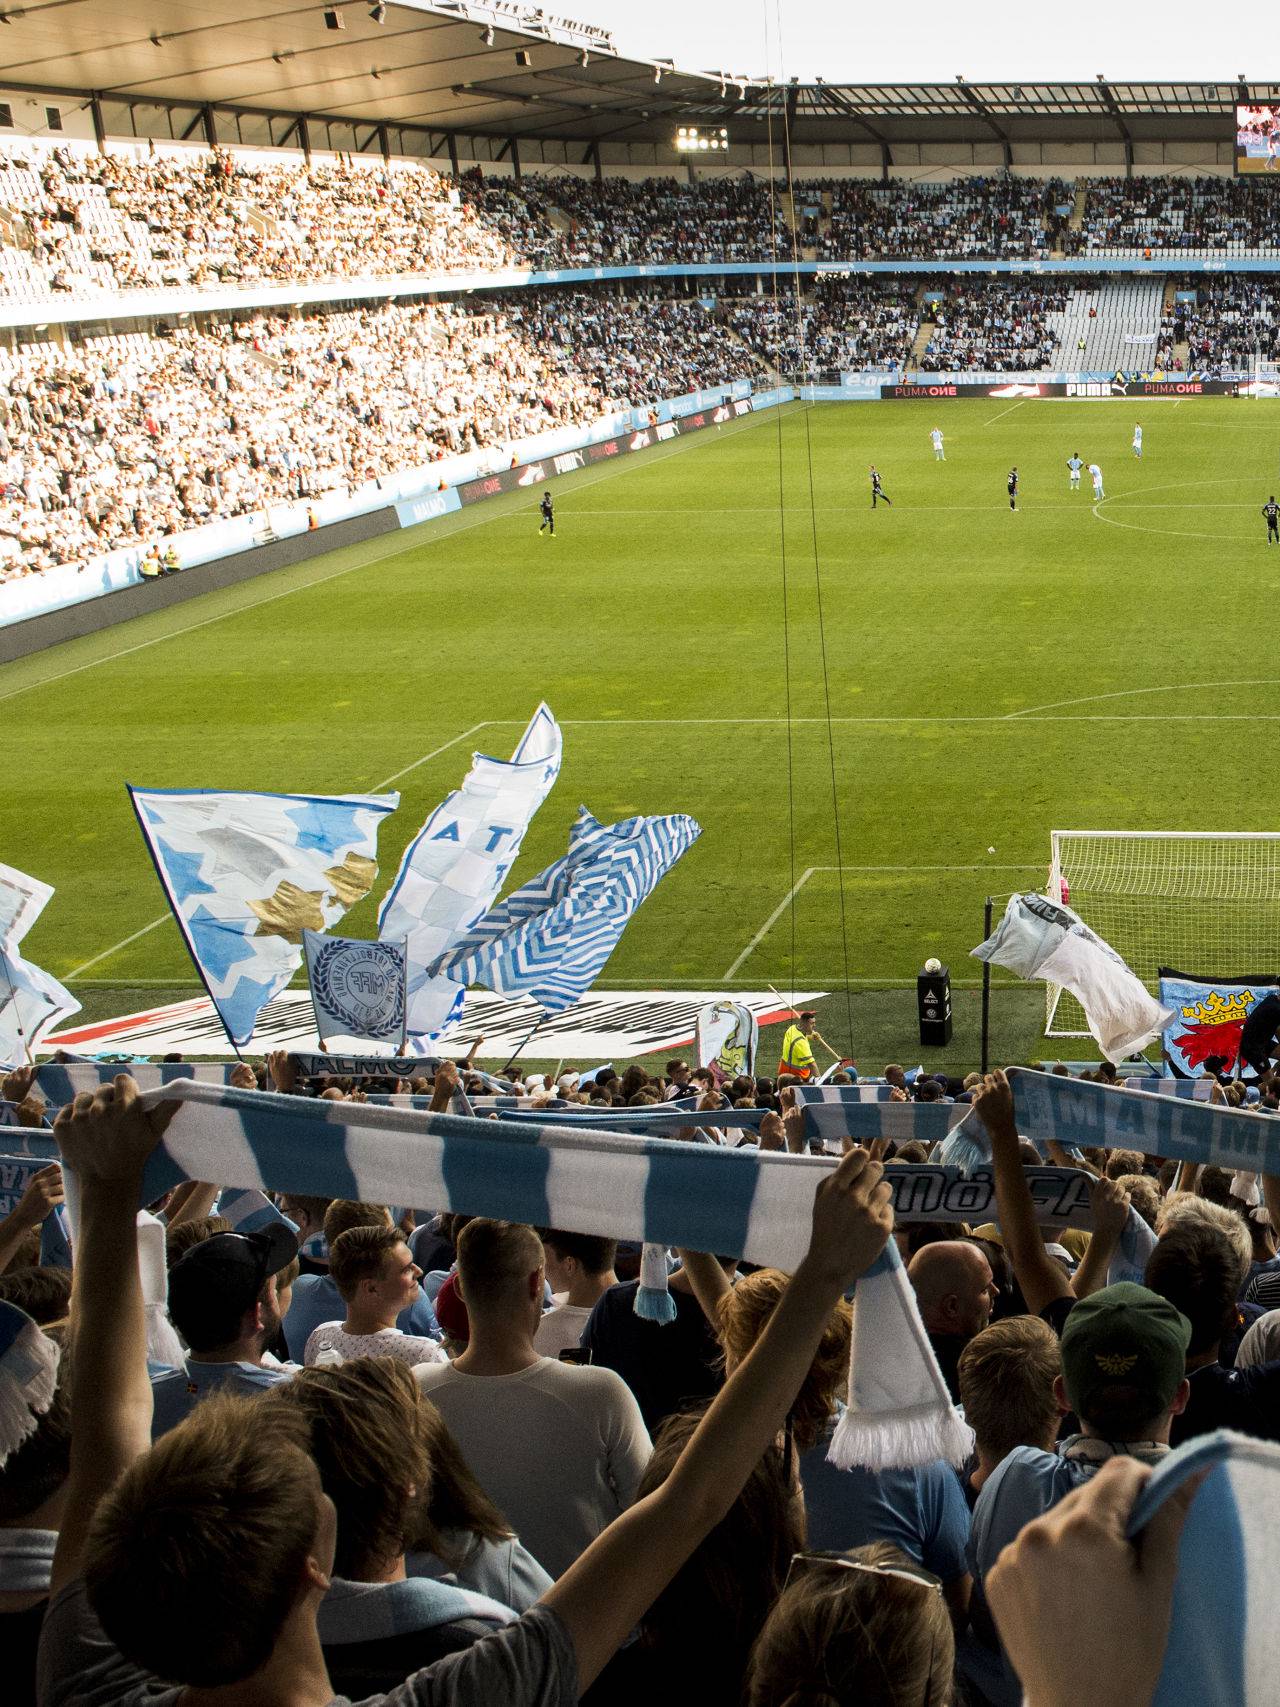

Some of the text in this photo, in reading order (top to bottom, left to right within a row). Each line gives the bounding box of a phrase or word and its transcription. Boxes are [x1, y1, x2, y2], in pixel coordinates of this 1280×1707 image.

[895, 387, 928, 397] PUMA
[1066, 383, 1111, 396] PUMA
[1145, 384, 1176, 394] PUMA
